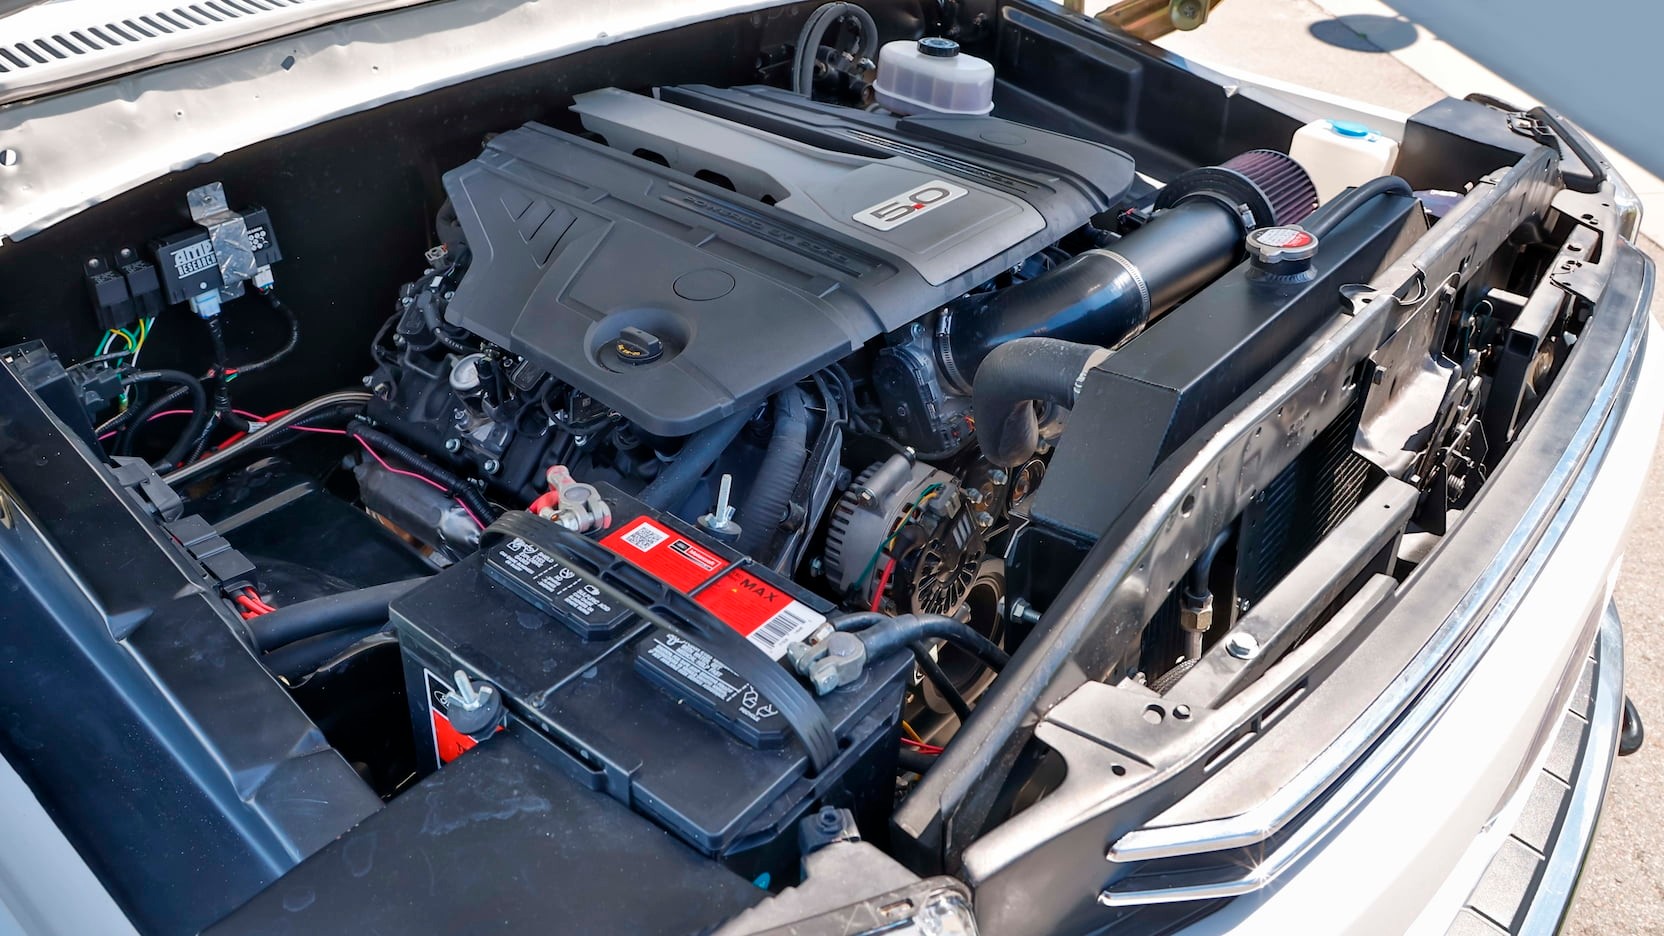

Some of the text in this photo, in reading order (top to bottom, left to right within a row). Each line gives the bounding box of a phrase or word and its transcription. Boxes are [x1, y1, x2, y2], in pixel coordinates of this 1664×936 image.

[869, 186, 951, 223] 5.0
[177, 253, 218, 276] RESEARCH
[740, 576, 780, 604] MAX
